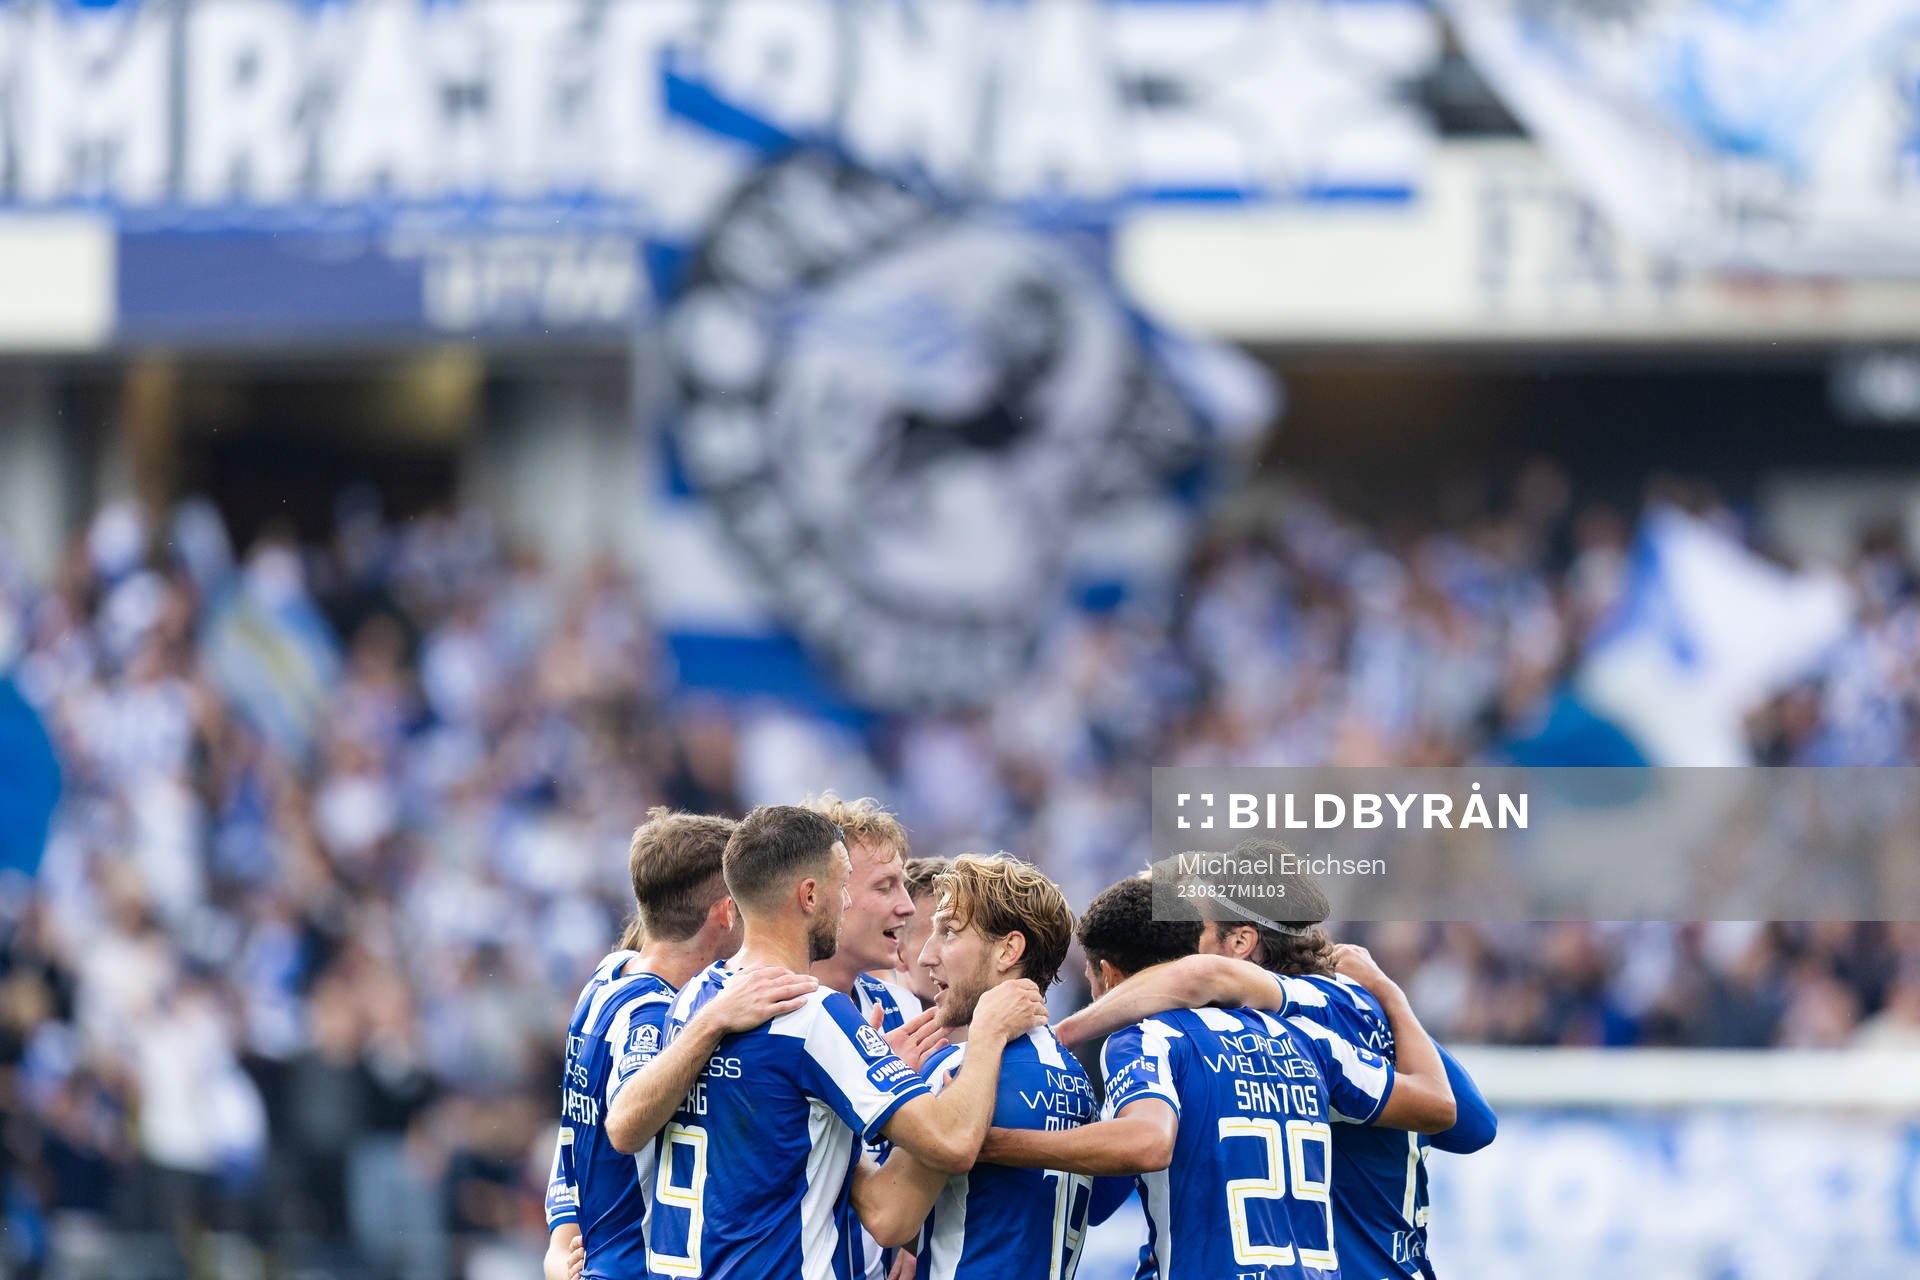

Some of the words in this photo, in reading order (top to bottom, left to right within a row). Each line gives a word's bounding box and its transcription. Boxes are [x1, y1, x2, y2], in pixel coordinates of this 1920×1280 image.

[1106, 1056, 1156, 1096] morris
[1235, 1079, 1320, 1117] SANTOS
[649, 1121, 708, 1280] 9
[1218, 1116, 1338, 1274] 29
